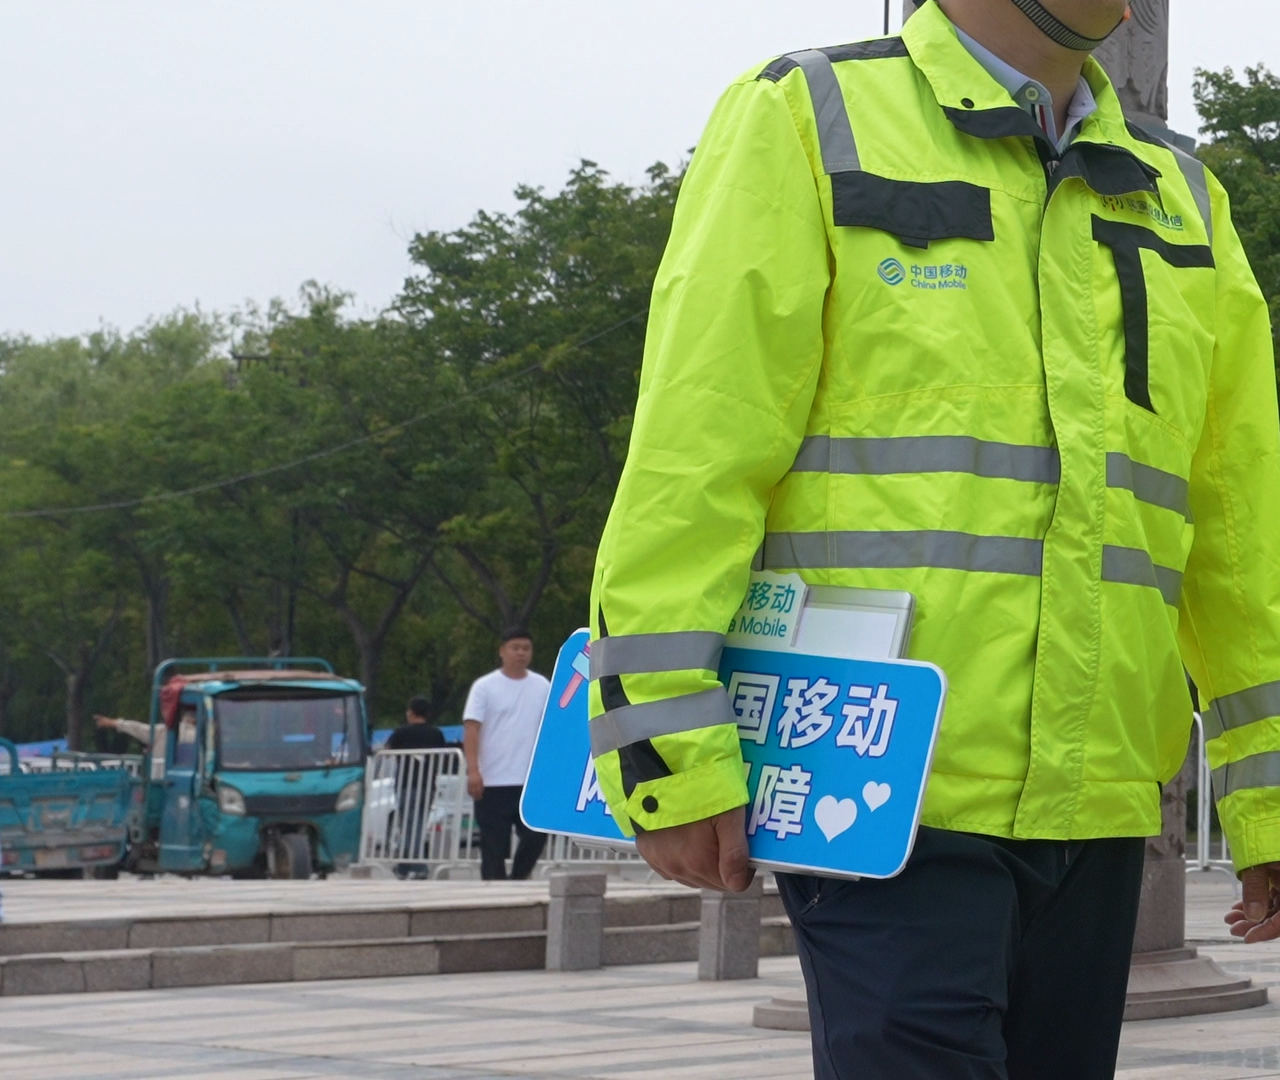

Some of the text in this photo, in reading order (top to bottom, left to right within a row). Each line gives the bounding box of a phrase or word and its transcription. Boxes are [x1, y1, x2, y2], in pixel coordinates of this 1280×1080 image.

[910, 264, 967, 279] 中国移动
[910, 278, 967, 290] China Mobile
[741, 581, 797, 614] 移动
[739, 617, 788, 638] Mobile
[728, 671, 899, 758] 国移动
[746, 763, 812, 840] 障
